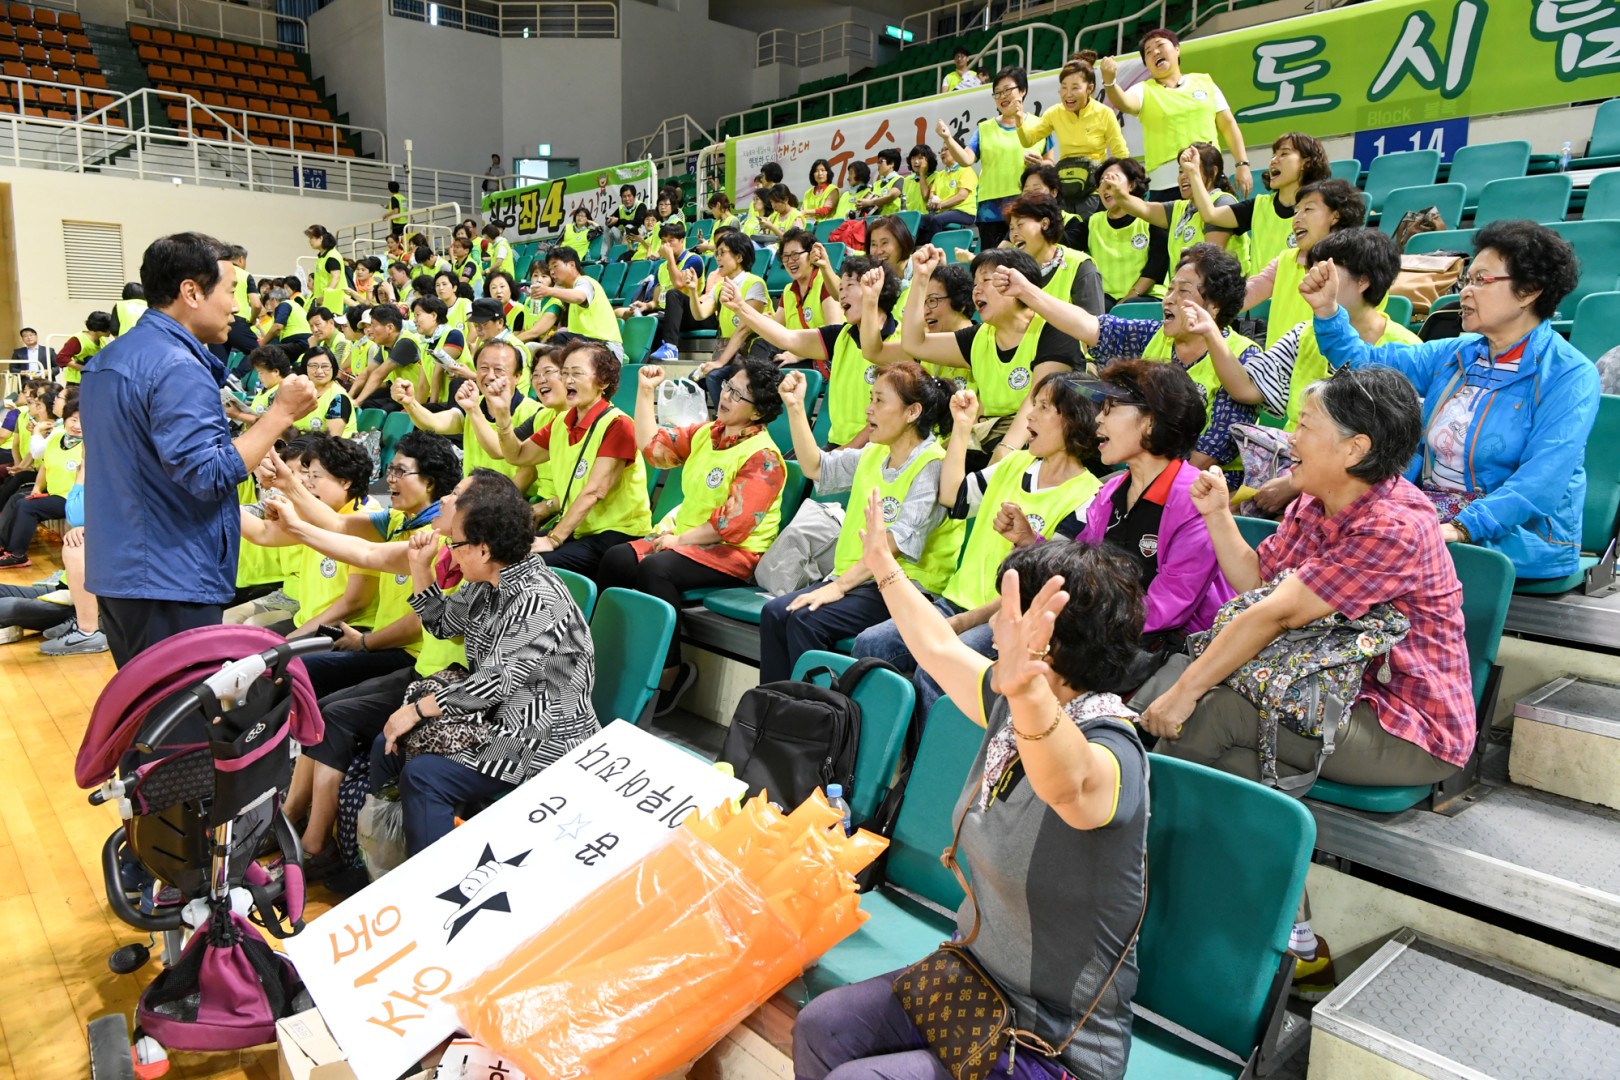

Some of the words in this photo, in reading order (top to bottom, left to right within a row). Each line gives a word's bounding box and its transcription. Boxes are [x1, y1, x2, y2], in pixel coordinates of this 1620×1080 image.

[1367, 107, 1412, 126] Block
[777, 140, 811, 161] 해운대
[1373, 127, 1446, 158] 1-14
[303, 176, 321, 189] -12
[575, 742, 698, 829] 이루어진다
